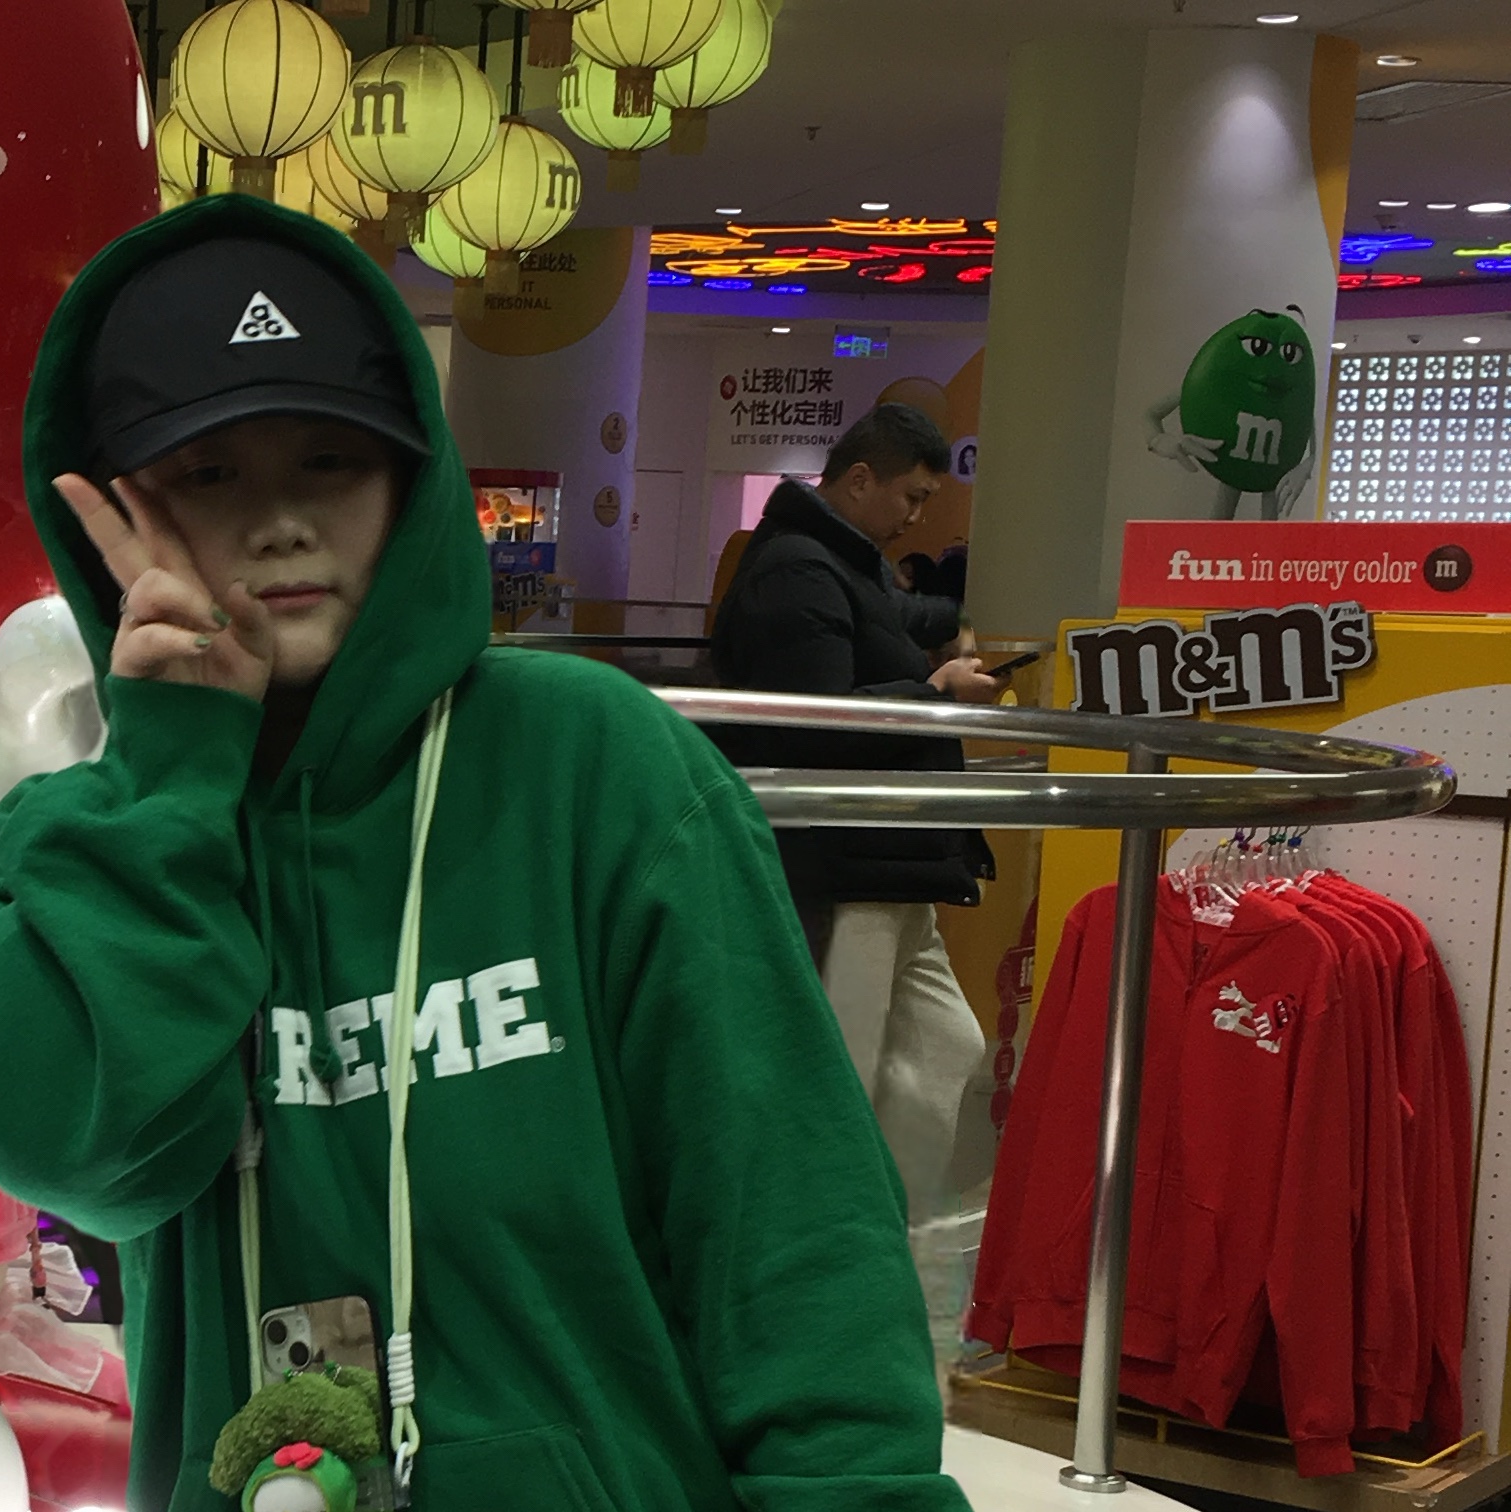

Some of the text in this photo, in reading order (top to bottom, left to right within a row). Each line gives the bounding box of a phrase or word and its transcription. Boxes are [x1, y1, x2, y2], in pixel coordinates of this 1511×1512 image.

[351, 81, 406, 136] m
[546, 162, 579, 210] m
[742, 367, 834, 394] 让我们来
[730, 400, 844, 427] 个性化定制
[731, 434, 840, 447] LET'S GET PERSONA
[1230, 412, 1282, 465] m
[1167, 550, 1244, 581] fun
[1250, 552, 1274, 582] in
[1279, 560, 1347, 591] every
[1354, 553, 1417, 585] color
